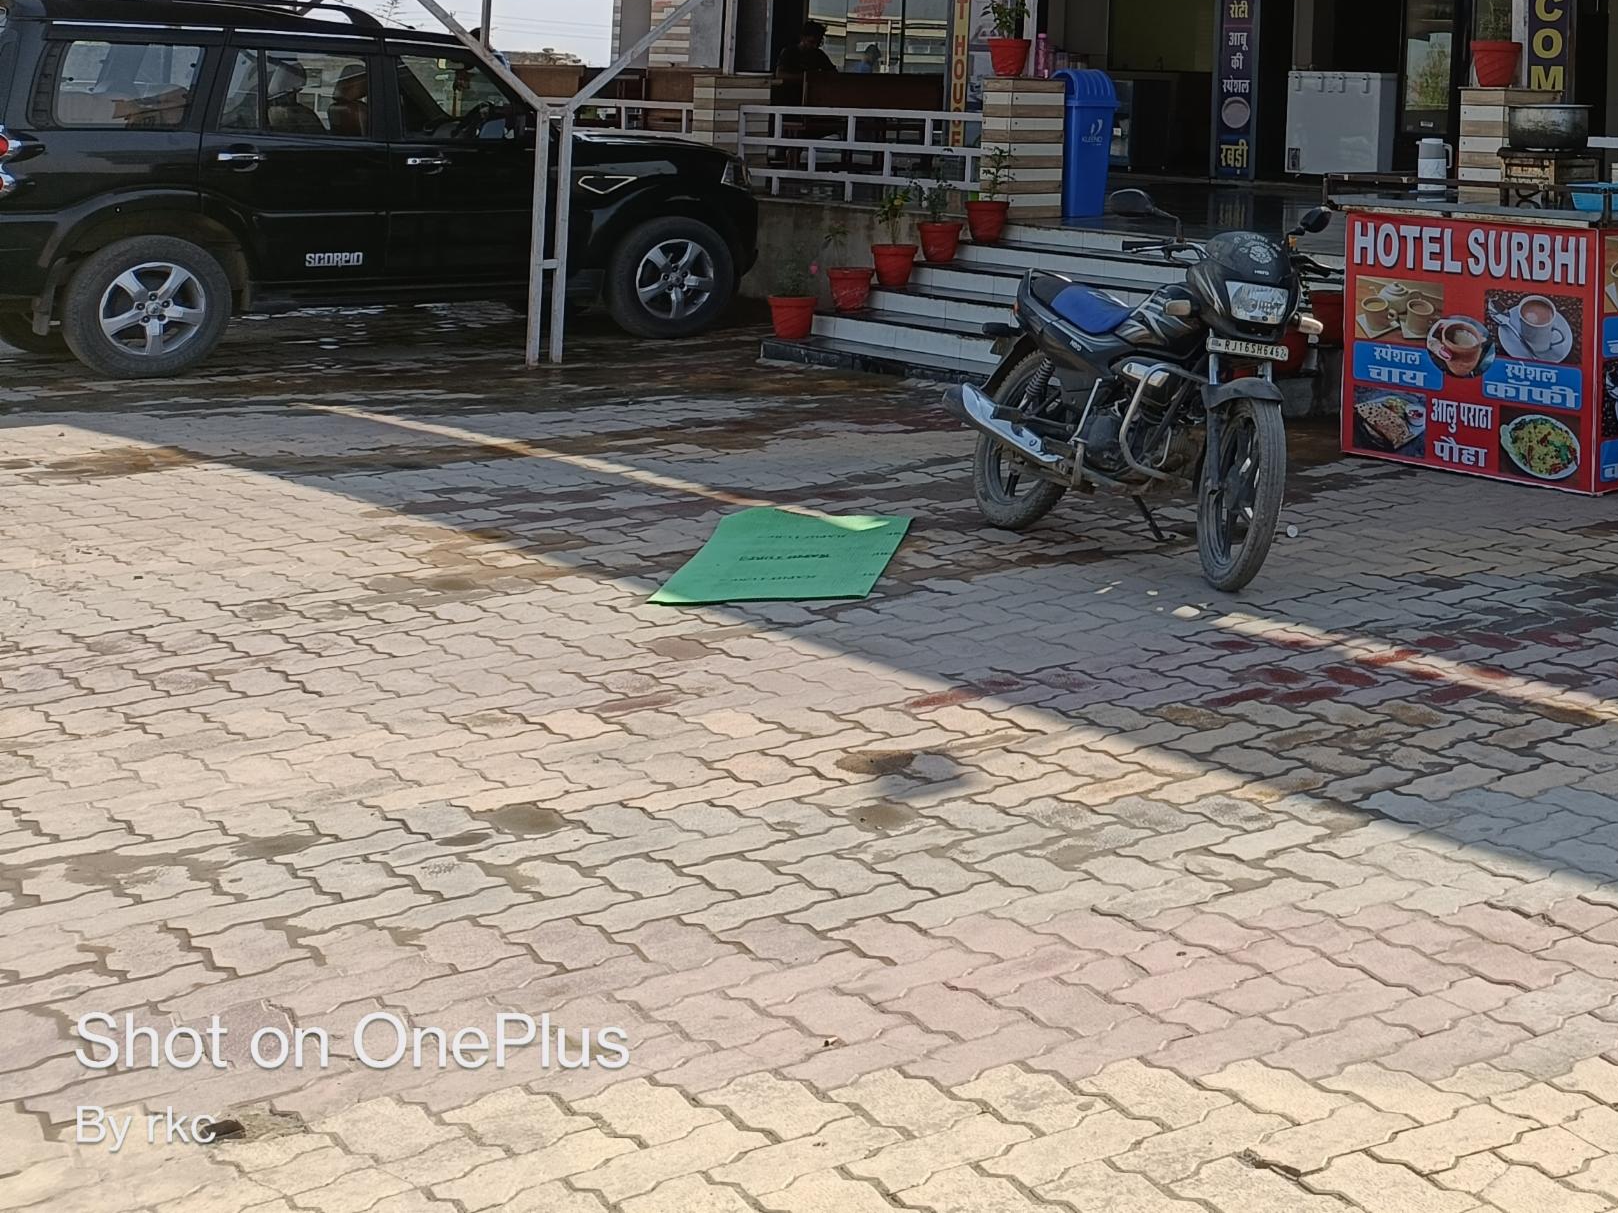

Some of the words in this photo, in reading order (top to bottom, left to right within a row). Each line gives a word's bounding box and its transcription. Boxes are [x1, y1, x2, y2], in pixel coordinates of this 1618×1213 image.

[1229, 0, 1249, 18] रोटी
[1230, 52, 1244, 69] की
[1219, 138, 1249, 175] रबड़ी
[304, 250, 364, 269] SCORPIO
[1353, 220, 1463, 274] HOTEL
[1466, 228, 1588, 286] SURBHI
[1373, 343, 1422, 366] स्पेशल
[1367, 364, 1428, 387] चाय
[1505, 361, 1559, 383] स्पेशल
[1483, 378, 1580, 410] कॉफी
[1459, 401, 1494, 430] पराठा
[1433, 435, 1488, 468] पौहा
